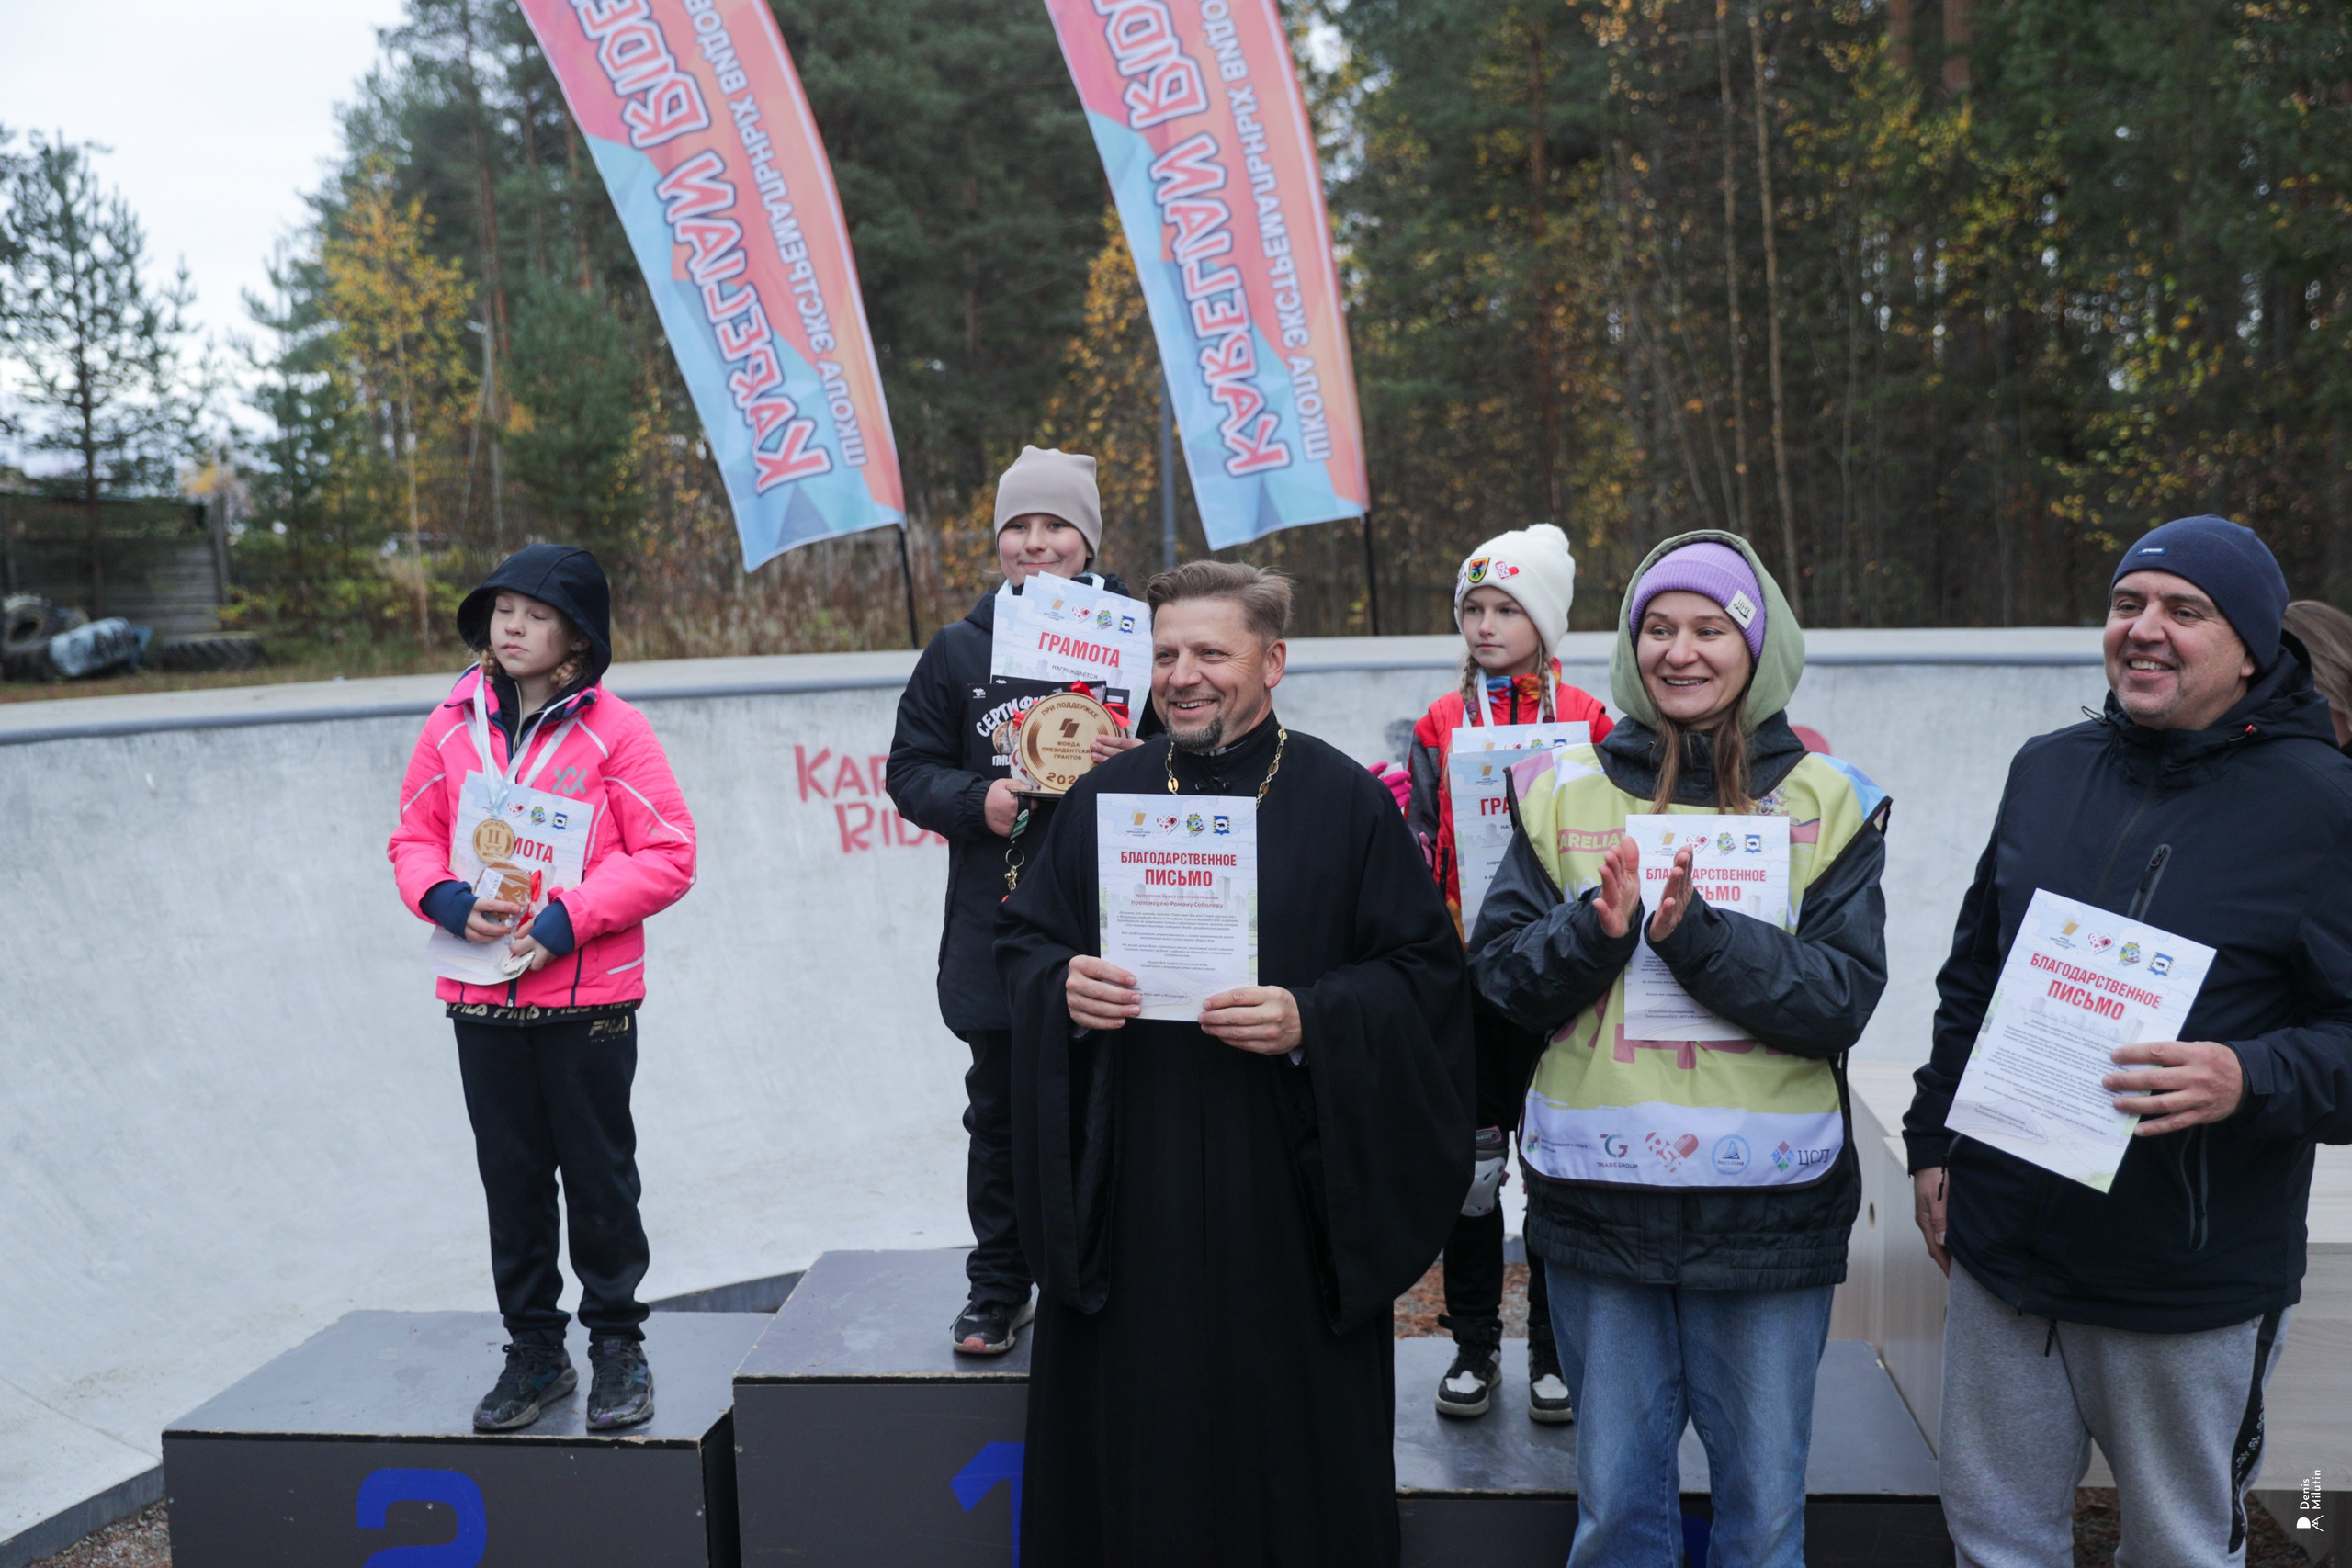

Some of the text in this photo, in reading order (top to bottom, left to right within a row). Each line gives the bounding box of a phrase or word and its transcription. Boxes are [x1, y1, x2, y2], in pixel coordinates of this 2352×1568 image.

[1038, 632, 1120, 668] ГРАМОТА
[1052, 664, 1099, 680] НАГРАЖДАЕТСЯ
[1041, 702, 1099, 719] ПРИ ПОДДЕРЖКЕ
[992, 755, 1012, 766] ПИЦ
[1046, 772, 1085, 785] 202
[1480, 796, 1510, 816] ГРА
[1559, 831, 1625, 850] ARELIA
[1121, 851, 1237, 867] БЛАГОДАРСТВЕННОЕ
[1145, 869, 1213, 887] ПИСЬМО
[1646, 868, 1766, 882] БЛААРСТВЕННОЕ
[1694, 886, 1741, 902] СЬМО
[1170, 900, 1193, 908] Роману
[1194, 901, 1224, 909] Соболеву
[2030, 953, 2162, 1009] БЛАГОДАРСТВЕННОЕ
[2047, 979, 2125, 1021] ПИСЬМО
[589, 1015, 629, 1036] FILA
[356, 1469, 487, 1568] 2
